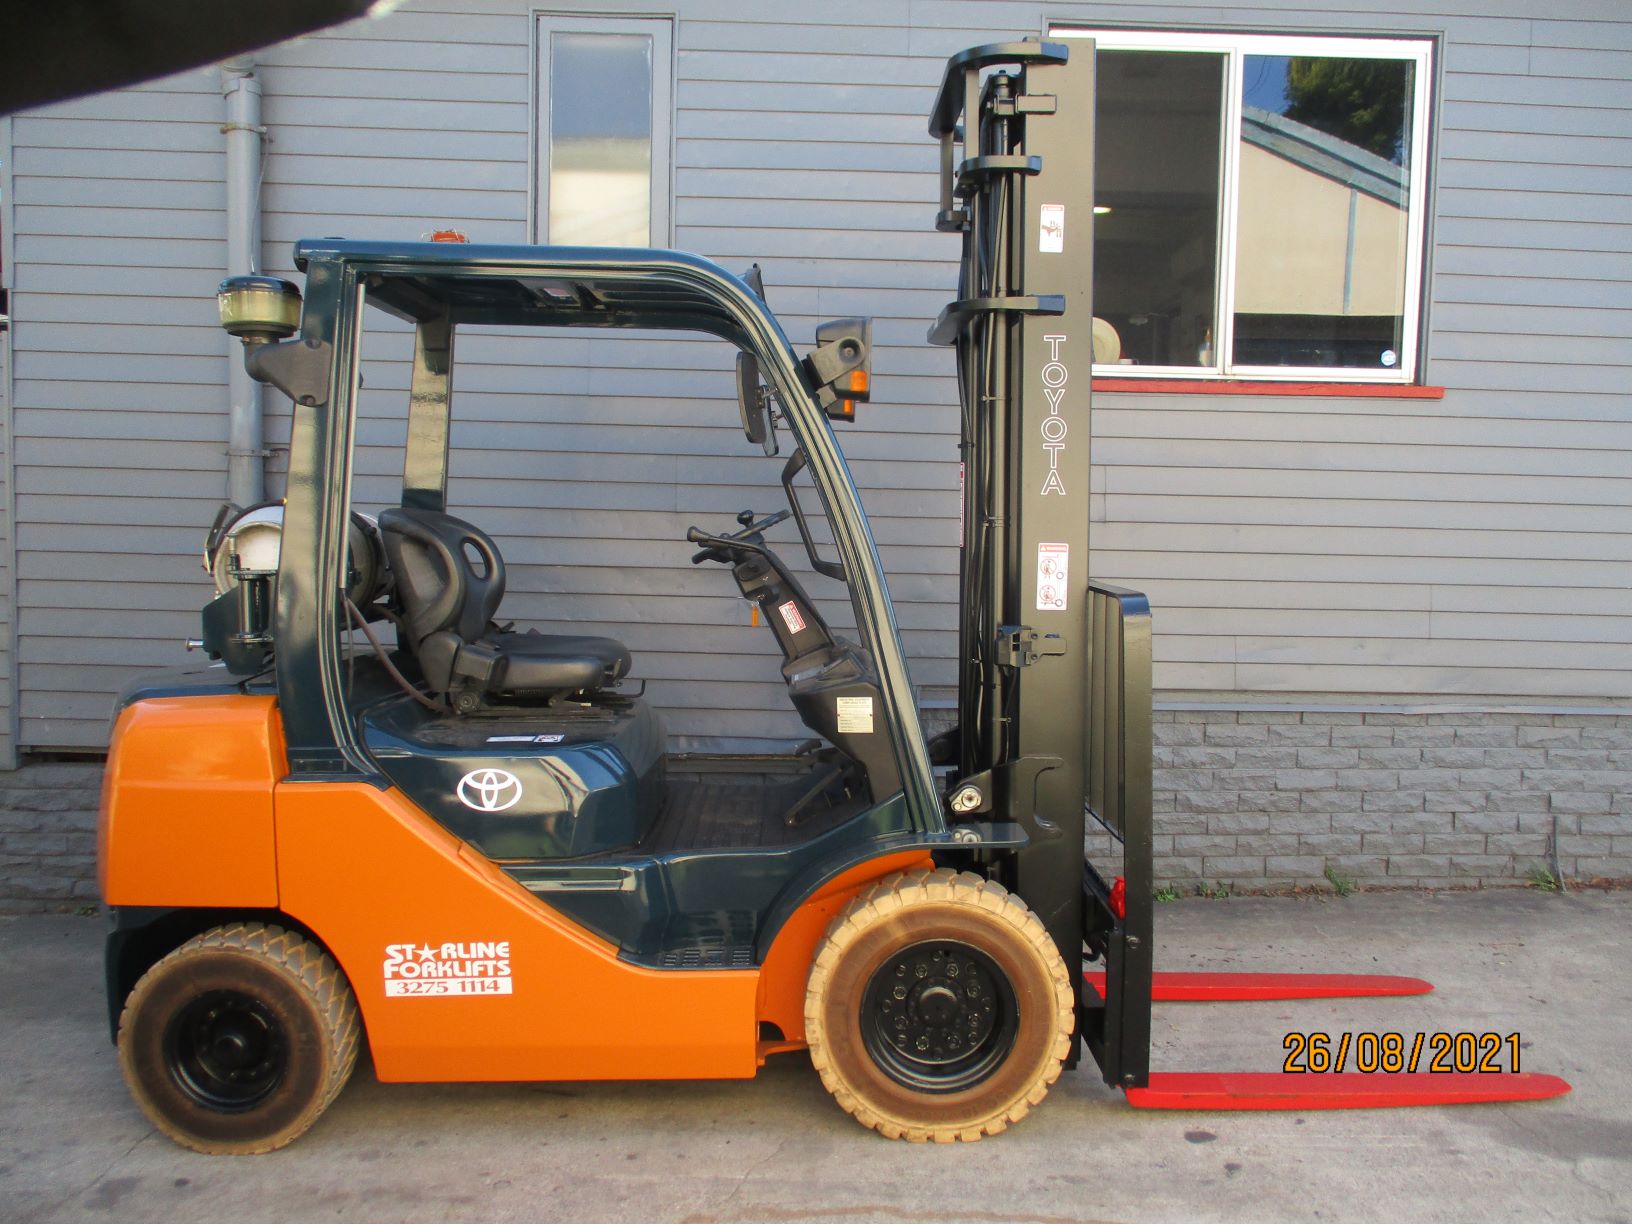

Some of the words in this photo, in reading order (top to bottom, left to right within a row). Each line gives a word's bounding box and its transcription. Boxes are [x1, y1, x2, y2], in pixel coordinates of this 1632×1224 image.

[1040, 334, 1068, 496] TOYOTA
[383, 959, 512, 979] FORKLIFTS
[396, 981, 449, 995] 3275
[457, 979, 501, 993] 1114
